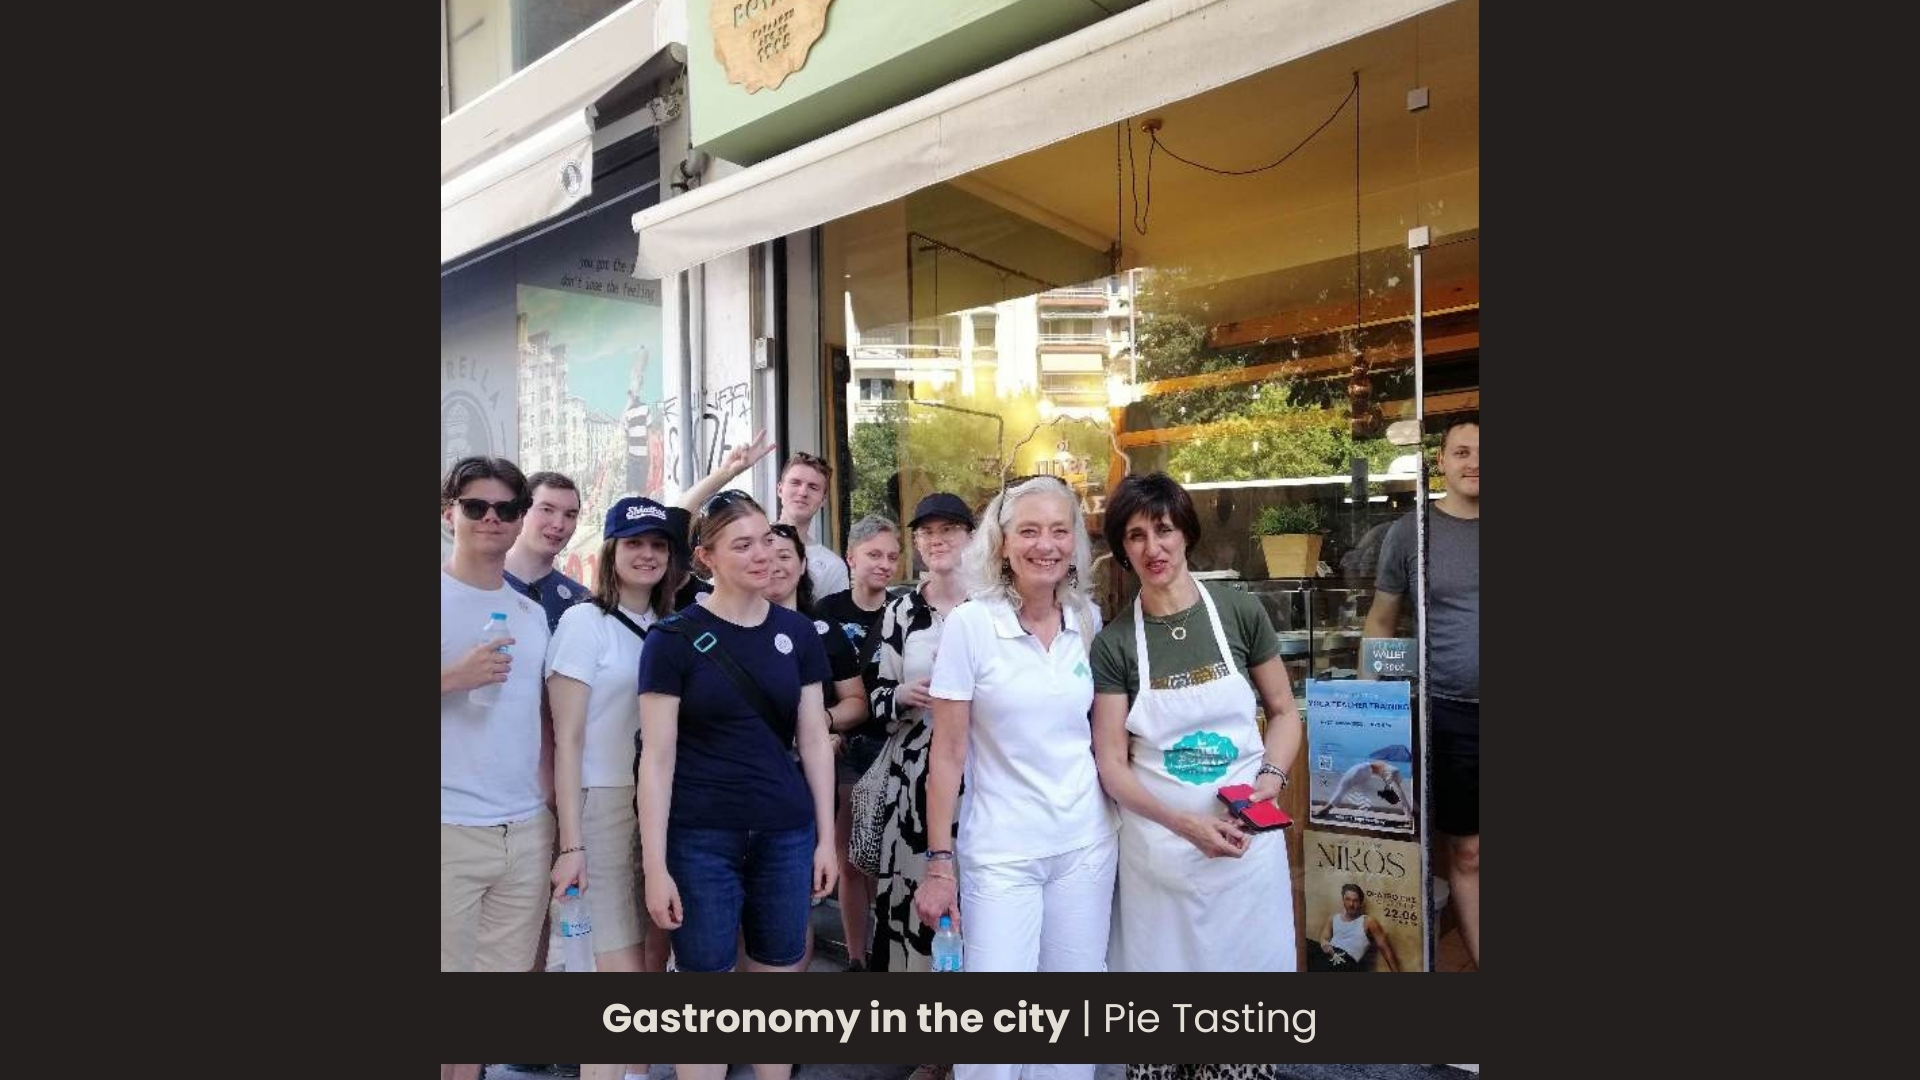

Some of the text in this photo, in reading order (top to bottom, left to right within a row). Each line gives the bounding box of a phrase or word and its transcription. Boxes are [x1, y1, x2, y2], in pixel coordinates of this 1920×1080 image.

[1373, 649, 1407, 659] WALLET
[1331, 700, 1368, 709] TEACHER
[1369, 702, 1410, 711] TRAINING
[1316, 842, 1406, 878] NIKOS
[1383, 907, 1418, 921] 22.06
